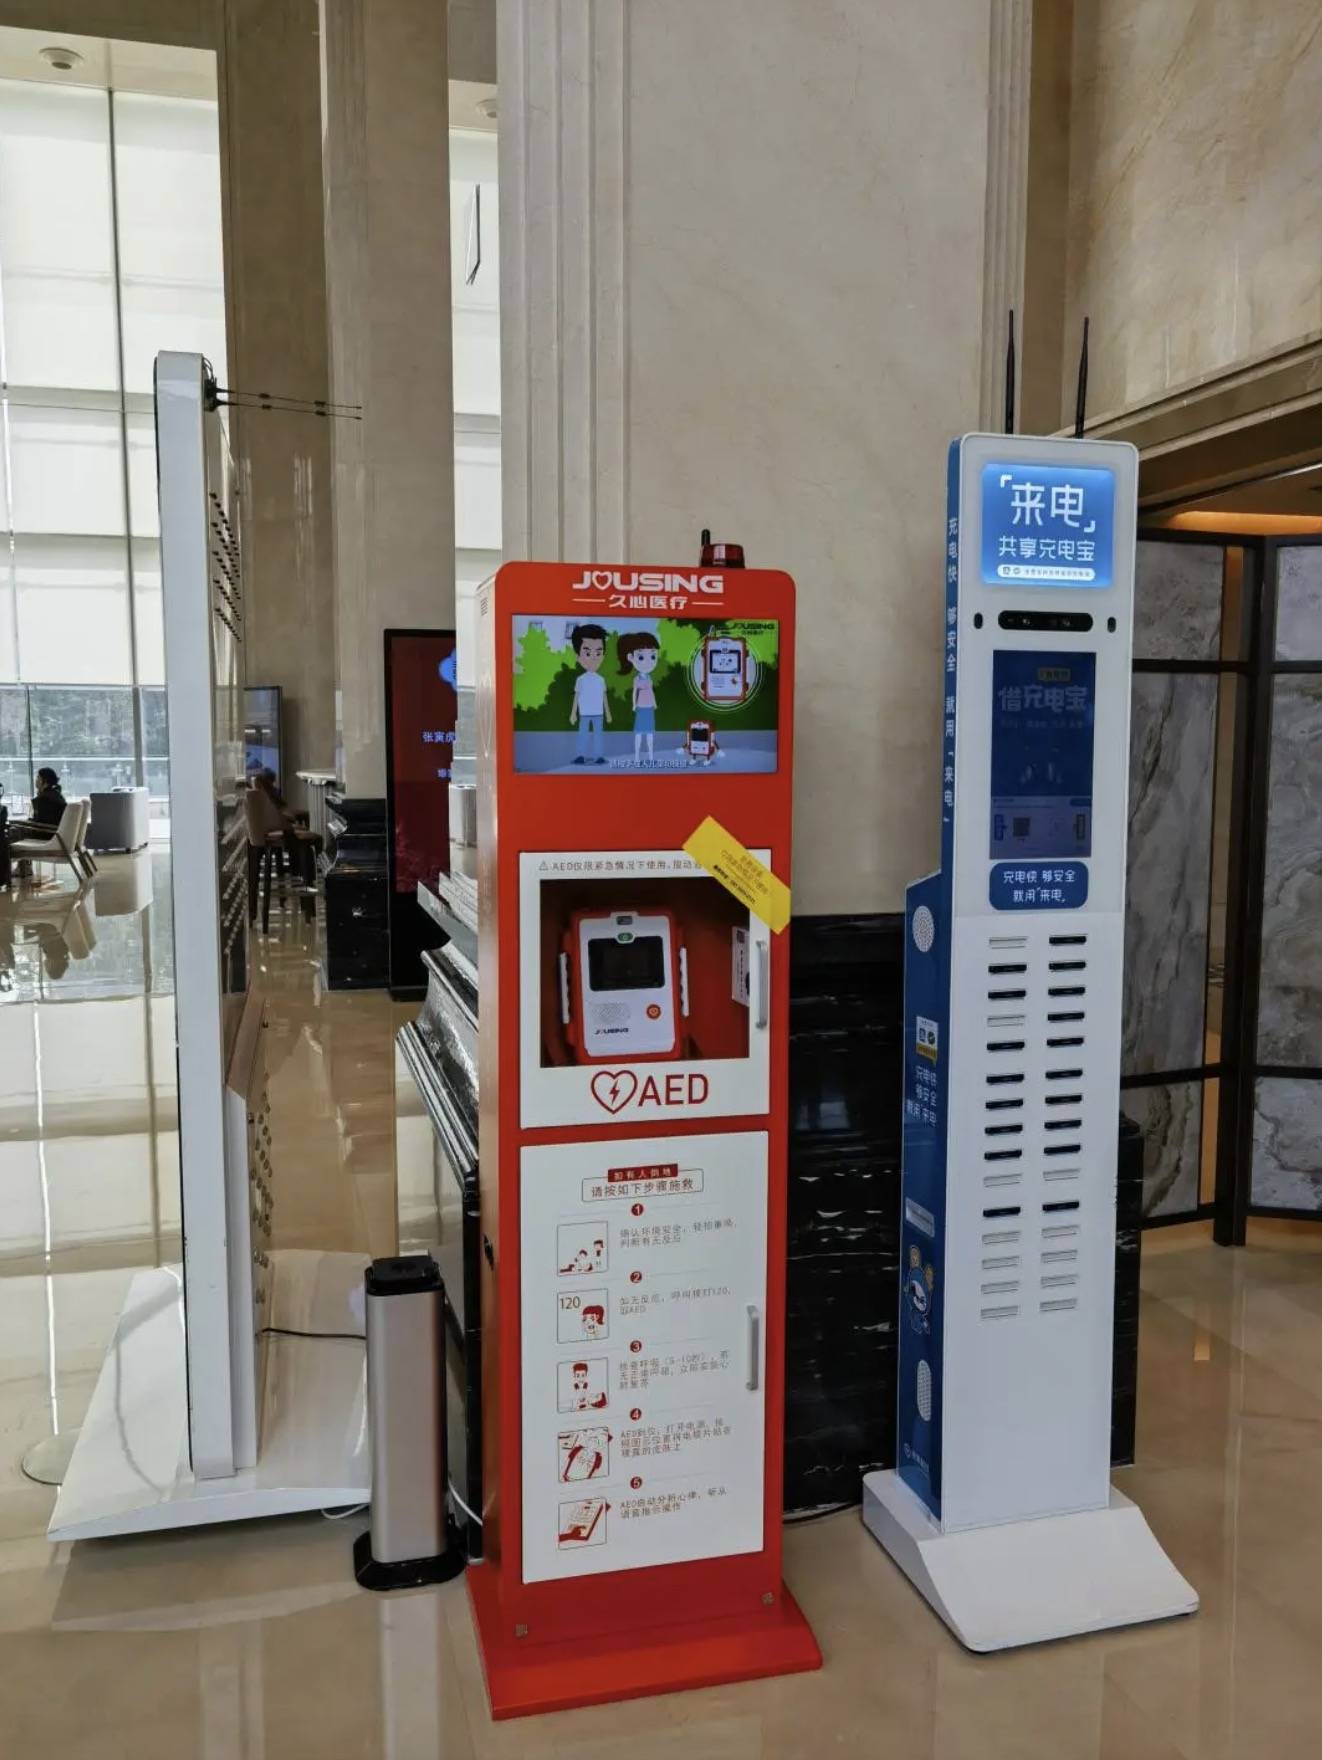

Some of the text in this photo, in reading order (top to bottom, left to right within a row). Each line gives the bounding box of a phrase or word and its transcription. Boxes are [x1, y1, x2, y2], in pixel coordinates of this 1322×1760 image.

[998, 535, 1096, 562] 共享充电宝
[572, 570, 724, 594] JOUSING
[608, 594, 689, 610] 久心医疗
[997, 684, 1088, 714] 借充电宝
[1003, 869, 1076, 884] 充电快 够安全
[638, 1073, 709, 1107] AED
[592, 1177, 694, 1198] 请按如下步骤施救
[560, 1296, 581, 1310] 120
